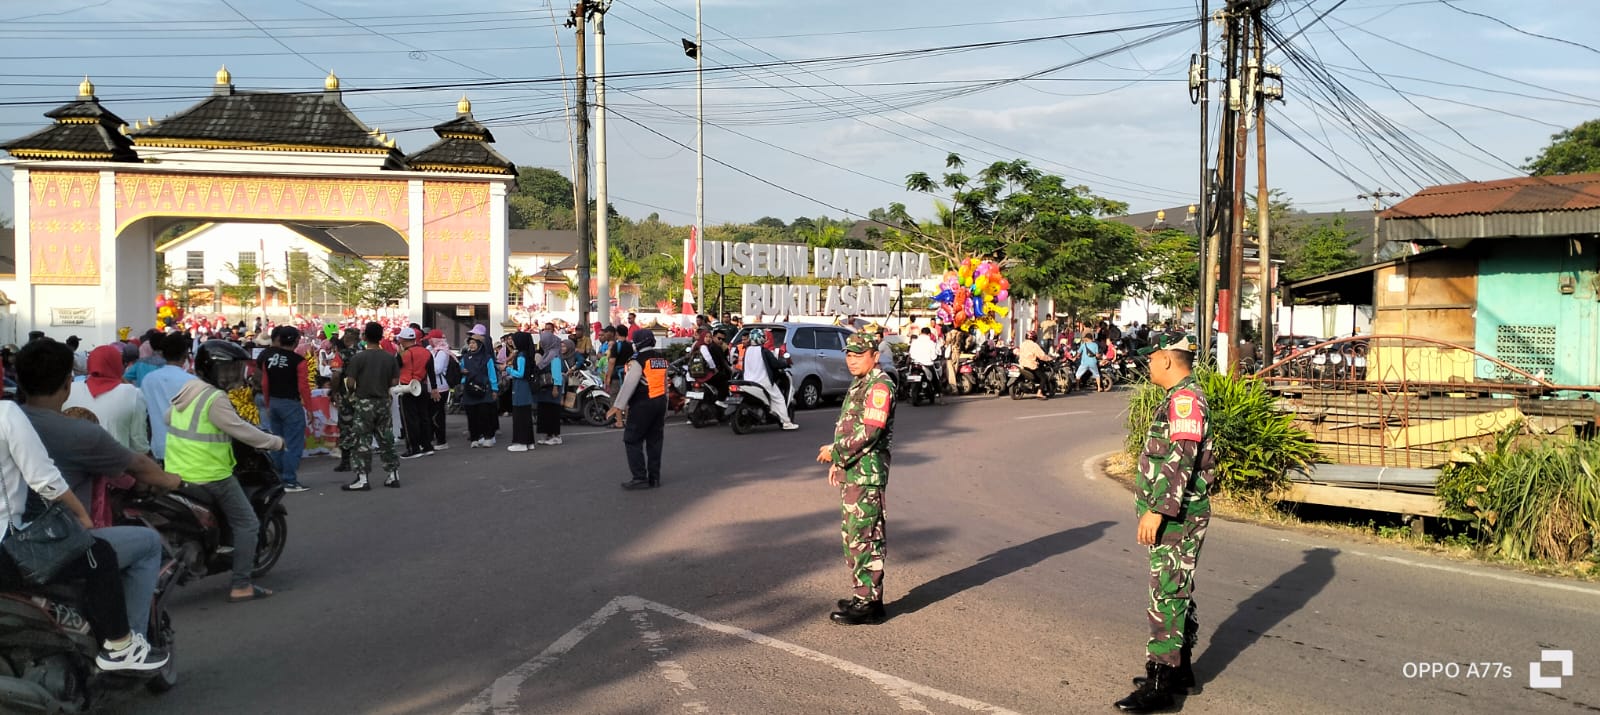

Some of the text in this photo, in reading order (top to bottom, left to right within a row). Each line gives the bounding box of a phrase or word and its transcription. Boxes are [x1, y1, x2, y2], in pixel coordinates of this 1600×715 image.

[814, 247, 932, 279] BATUBARA
[742, 284, 890, 316] BUKIT ASAM
[267, 353, 280, 369] 78
